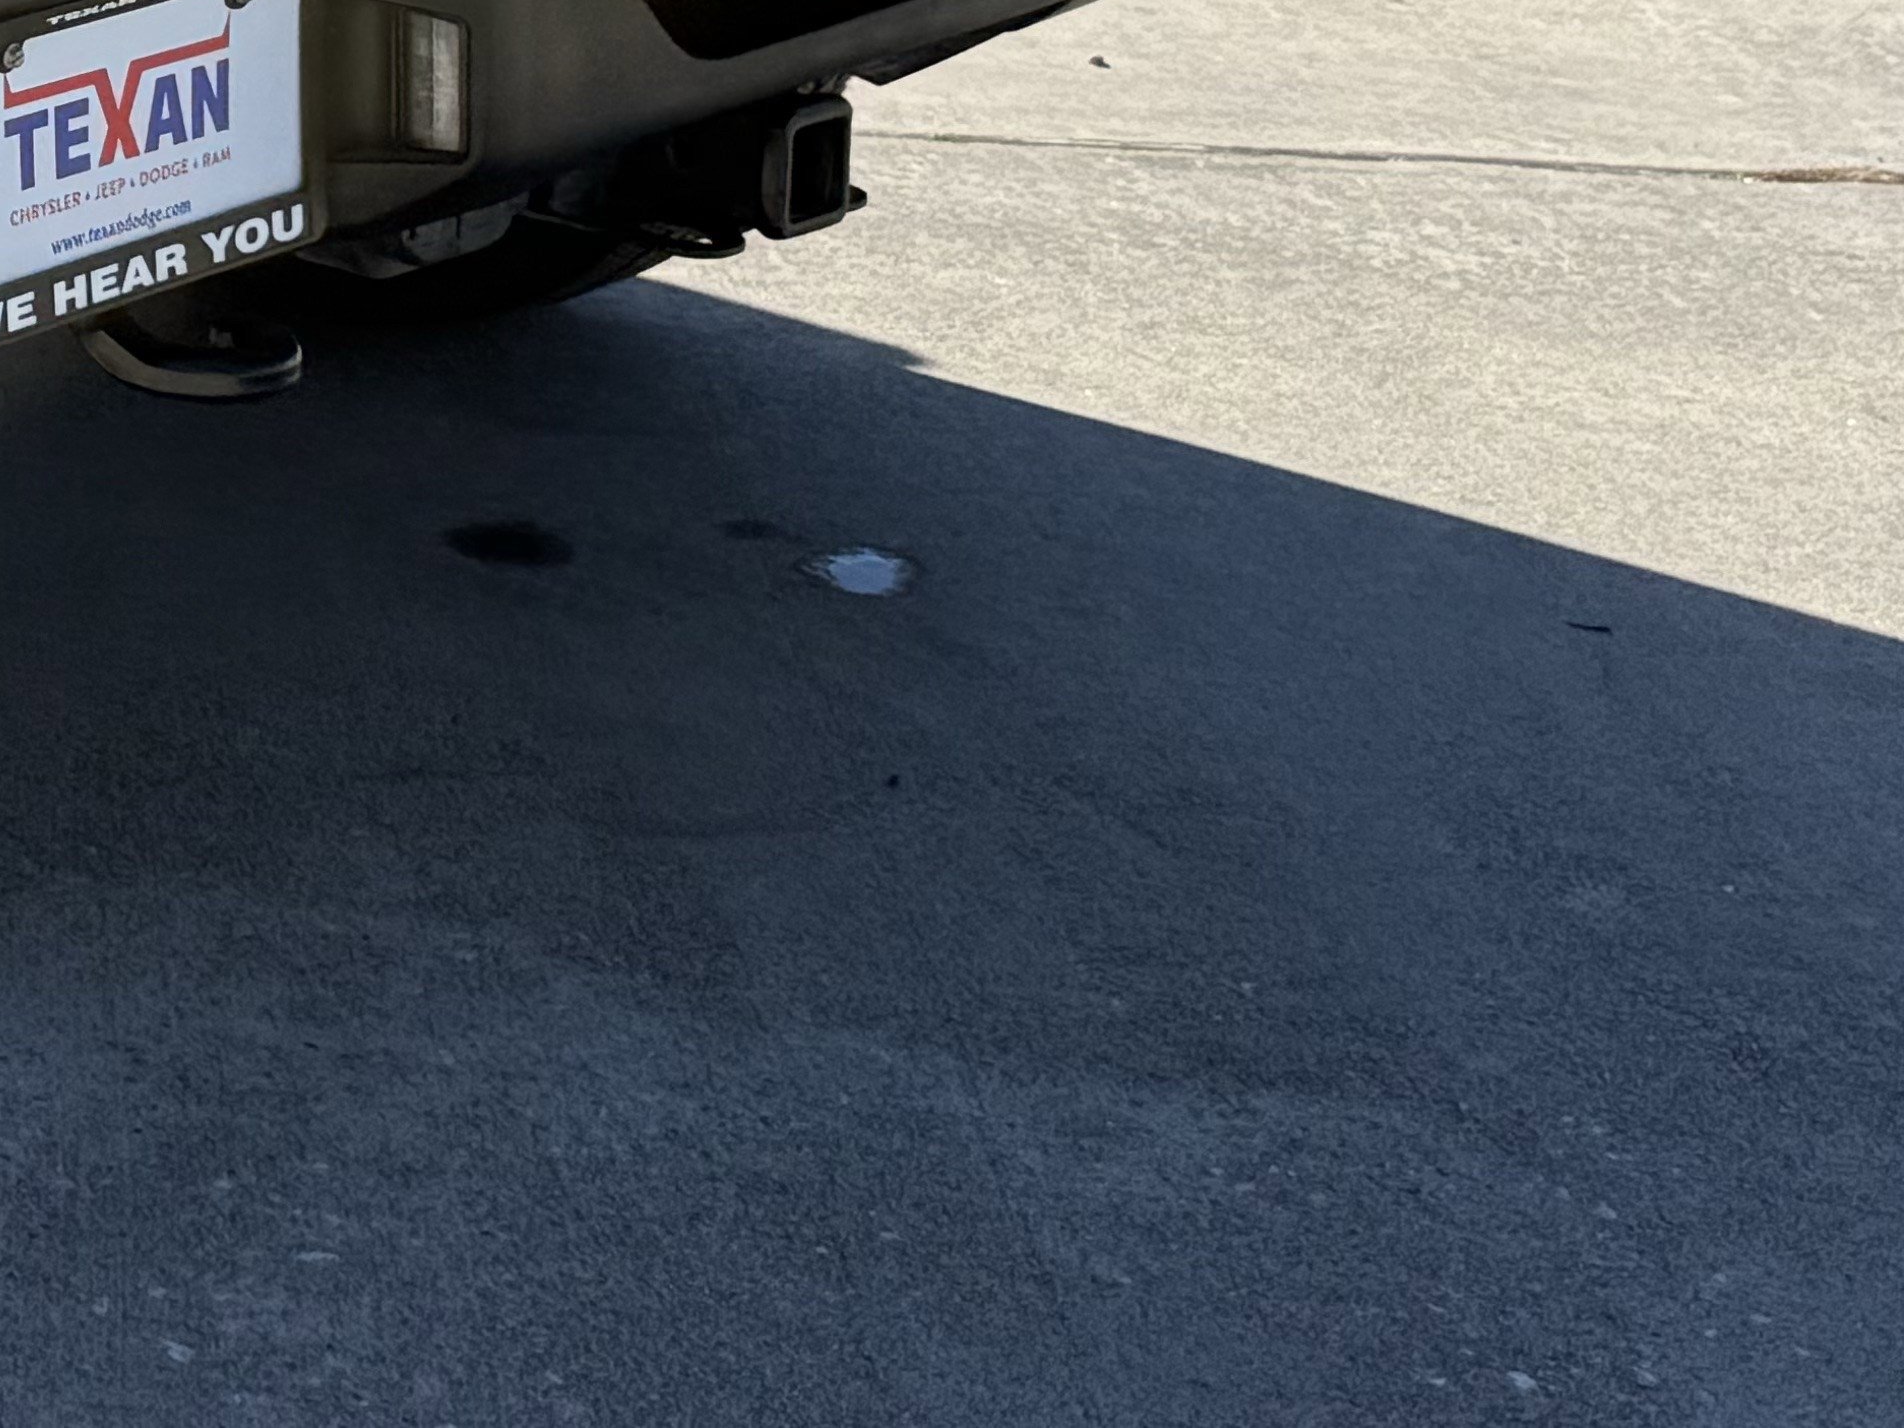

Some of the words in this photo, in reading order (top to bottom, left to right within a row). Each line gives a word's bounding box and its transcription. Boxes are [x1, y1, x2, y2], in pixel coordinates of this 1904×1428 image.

[3, 47, 230, 191] TEXAN
[10, 191, 82, 227] CHRYSLER
[94, 177, 126, 201] JEEP
[138, 158, 190, 187] DODGE
[202, 146, 231, 168] RAM
[53, 242, 188, 317] HEAR
[200, 204, 305, 265] YOU
